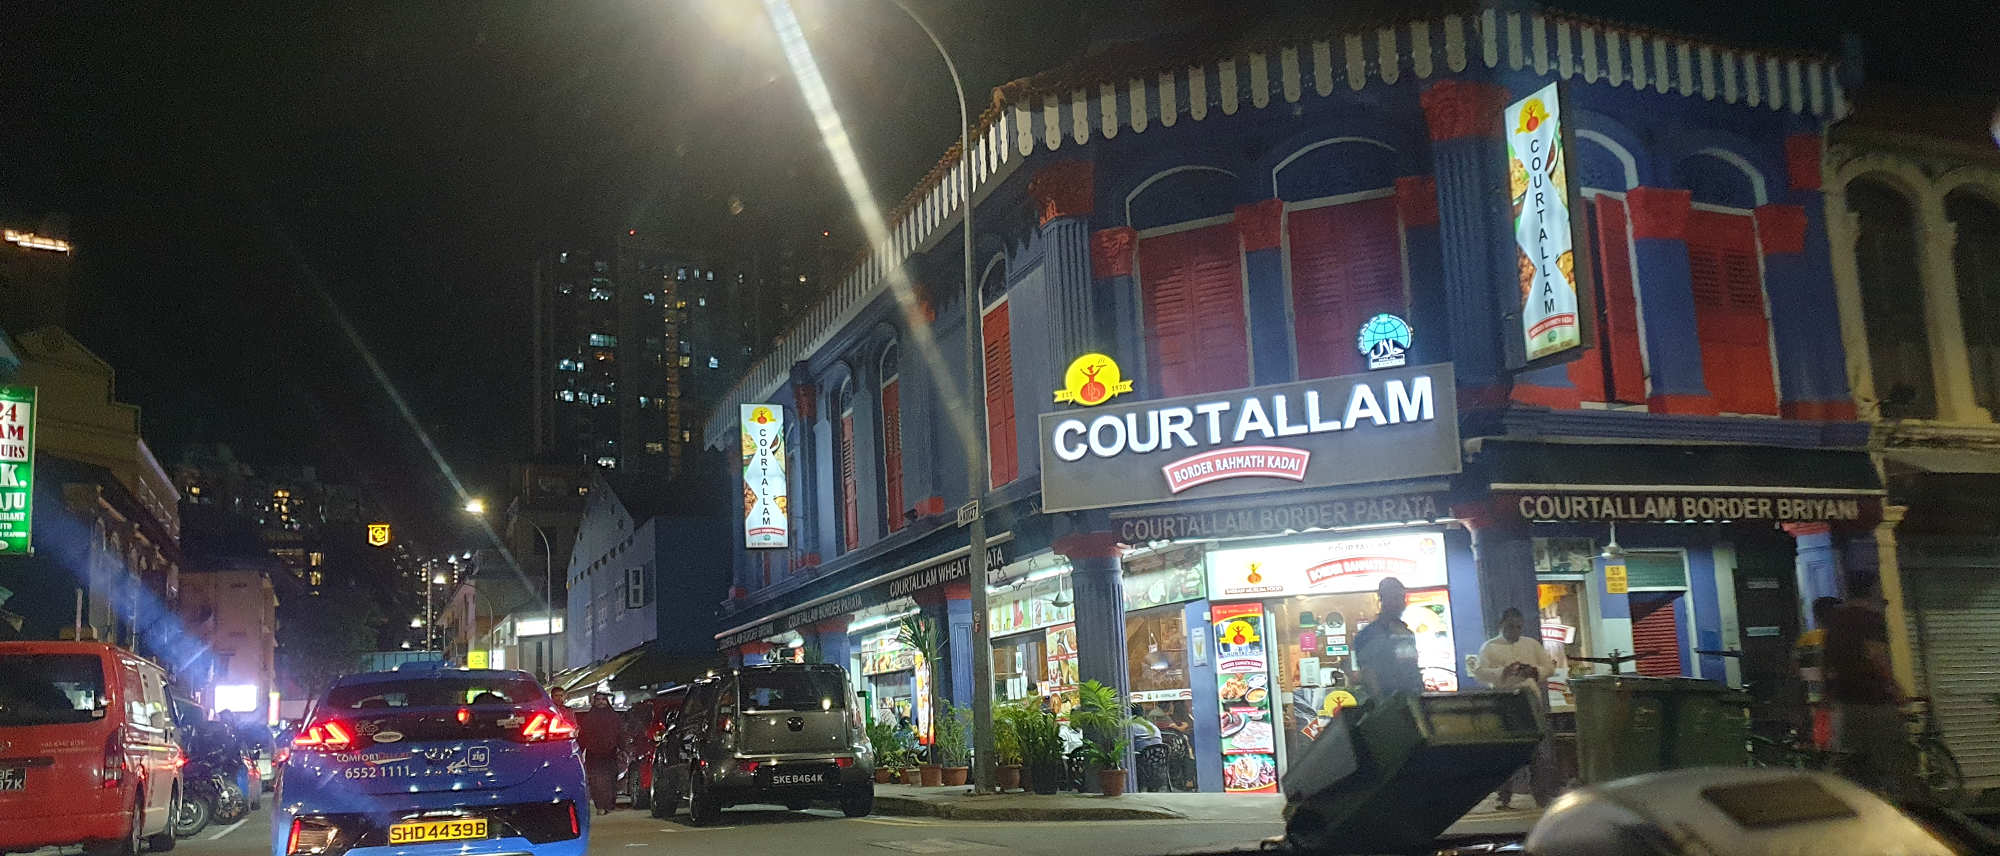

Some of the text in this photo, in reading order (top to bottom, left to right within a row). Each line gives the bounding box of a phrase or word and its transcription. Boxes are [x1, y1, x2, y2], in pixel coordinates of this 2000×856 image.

[1530, 139, 1555, 314] COURTALLAM
[1053, 375, 1435, 461] COURTALLAM
[759, 428, 771, 526] COURTALLAM
[1173, 455, 1301, 484] BORDER RAHMATH KADAI
[1122, 497, 1438, 542] COURTALLAM BORDER PARATA
[1519, 495, 1860, 521] COURTALLAM BORDER BRIYANI
[889, 567, 938, 598] COURTALLAM
[939, 559, 967, 583] WHEAT
[1309, 562, 1344, 582] BORDER
[471, 750, 486, 762] zig
[345, 765, 410, 779] 6552 1111
[391, 822, 486, 841] SHD4439B
